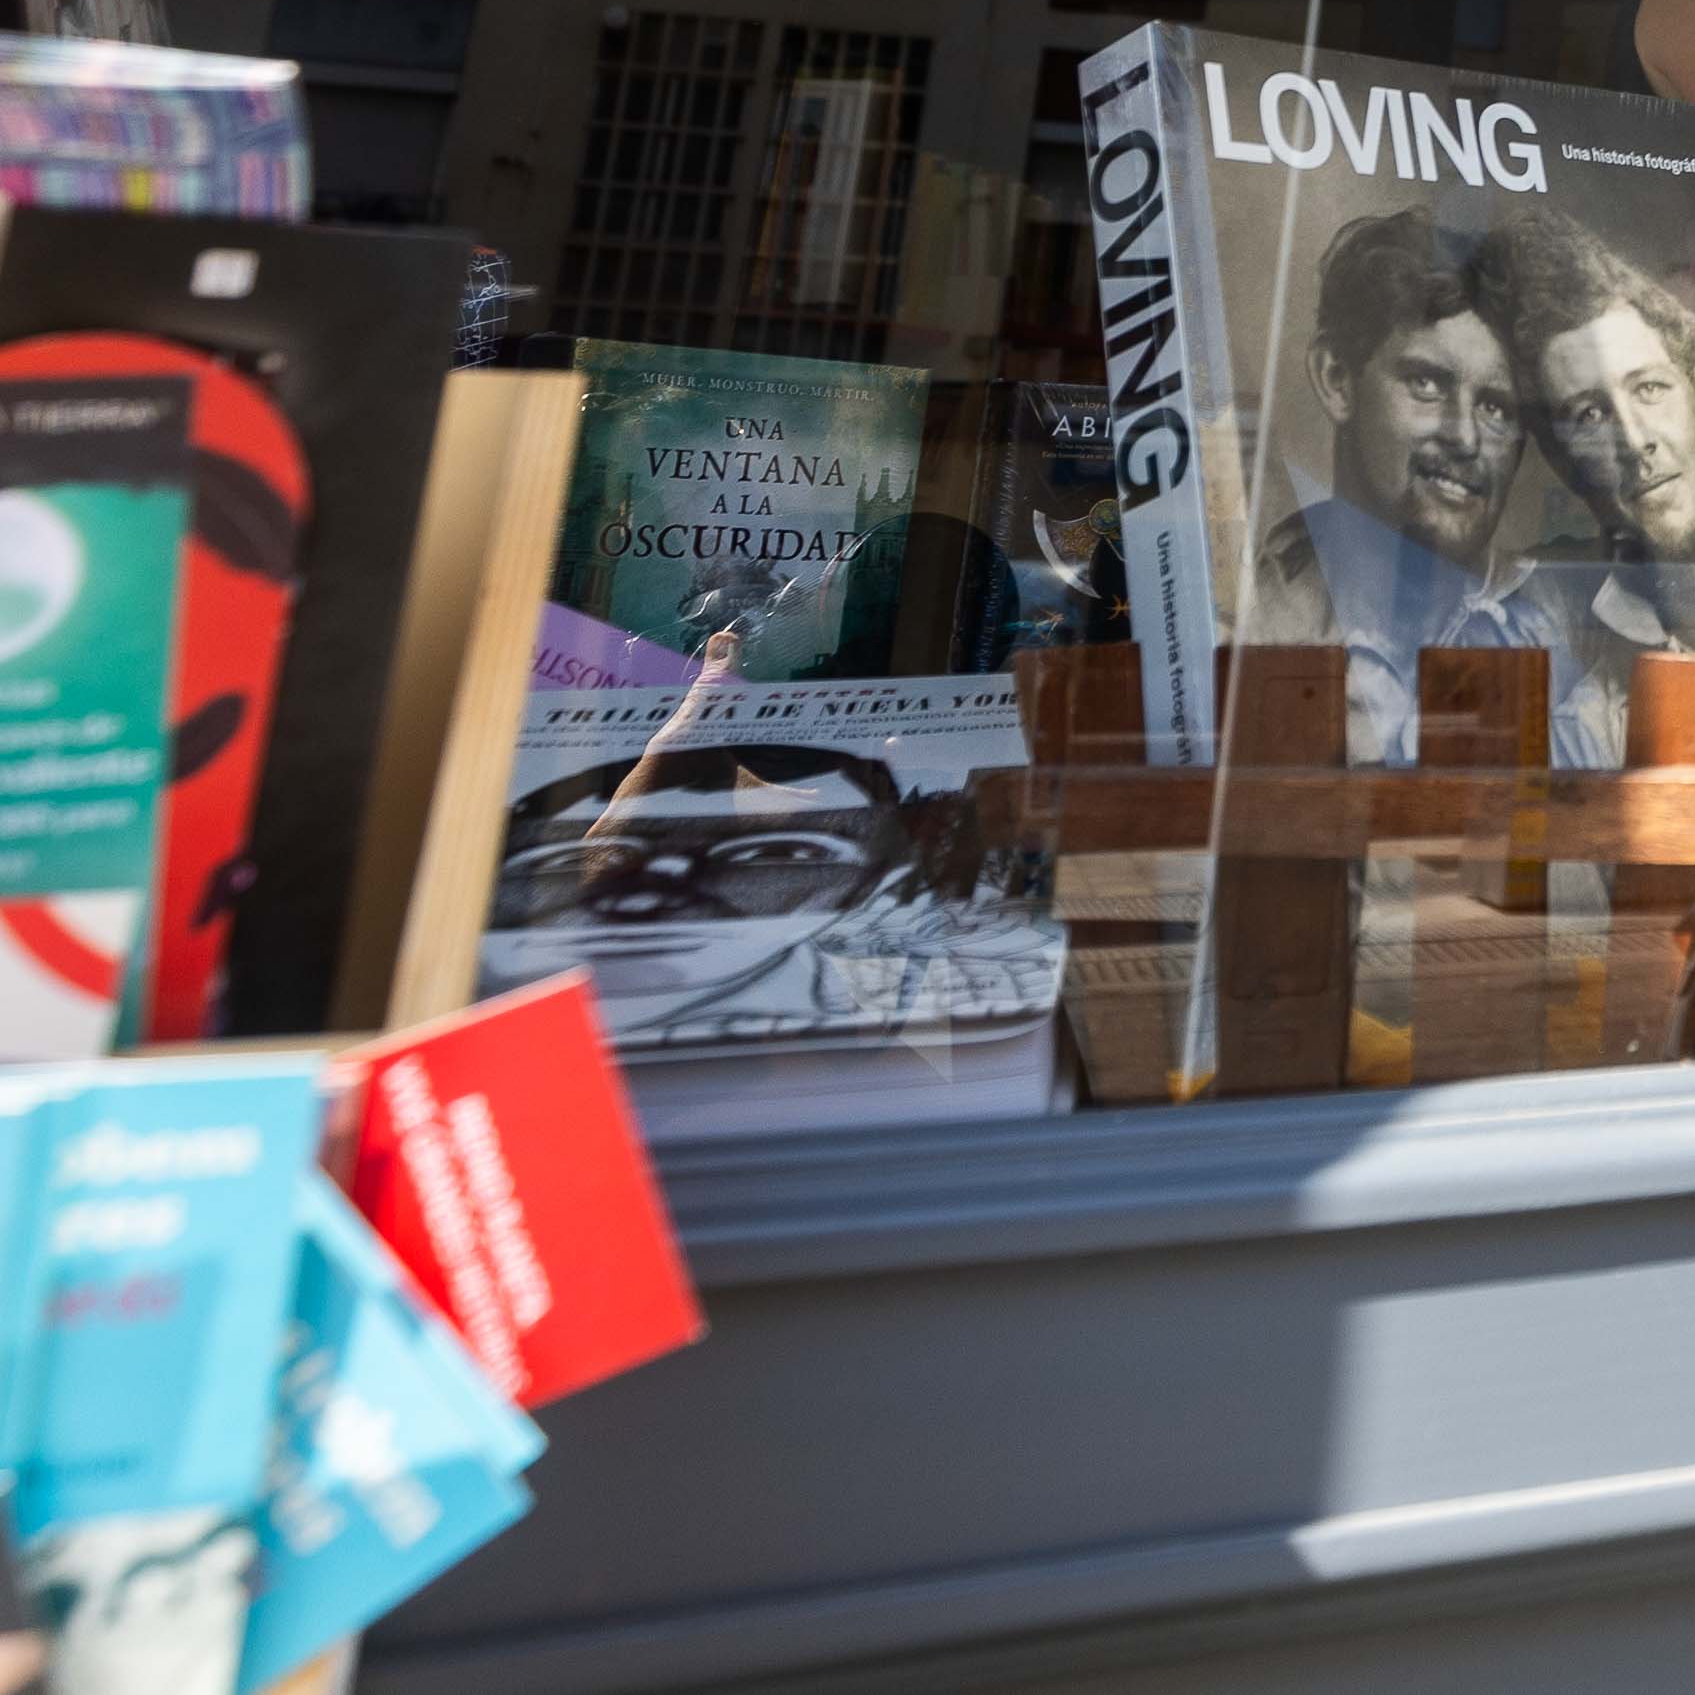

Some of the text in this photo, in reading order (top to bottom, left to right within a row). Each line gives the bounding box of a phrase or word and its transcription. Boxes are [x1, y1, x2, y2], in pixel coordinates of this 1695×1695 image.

[1203, 62, 1547, 193] LOVING
[1561, 143, 1591, 161] Una
[1592, 146, 1644, 168] historia
[1082, 60, 1192, 514] LOVING
[725, 416, 784, 440] UNA
[645, 447, 846, 487] VENTANA
[710, 494, 774, 516] A LA
[601, 522, 864, 562] OSCURIDAD
[1156, 530, 1171, 578] Una
[1161, 579, 1181, 665] historia
[547, 703, 738, 725] TRILOÍA
[756, 703, 804, 719] DE
[819, 695, 930, 717] NUEVA
[952, 691, 1018, 708] YOR
